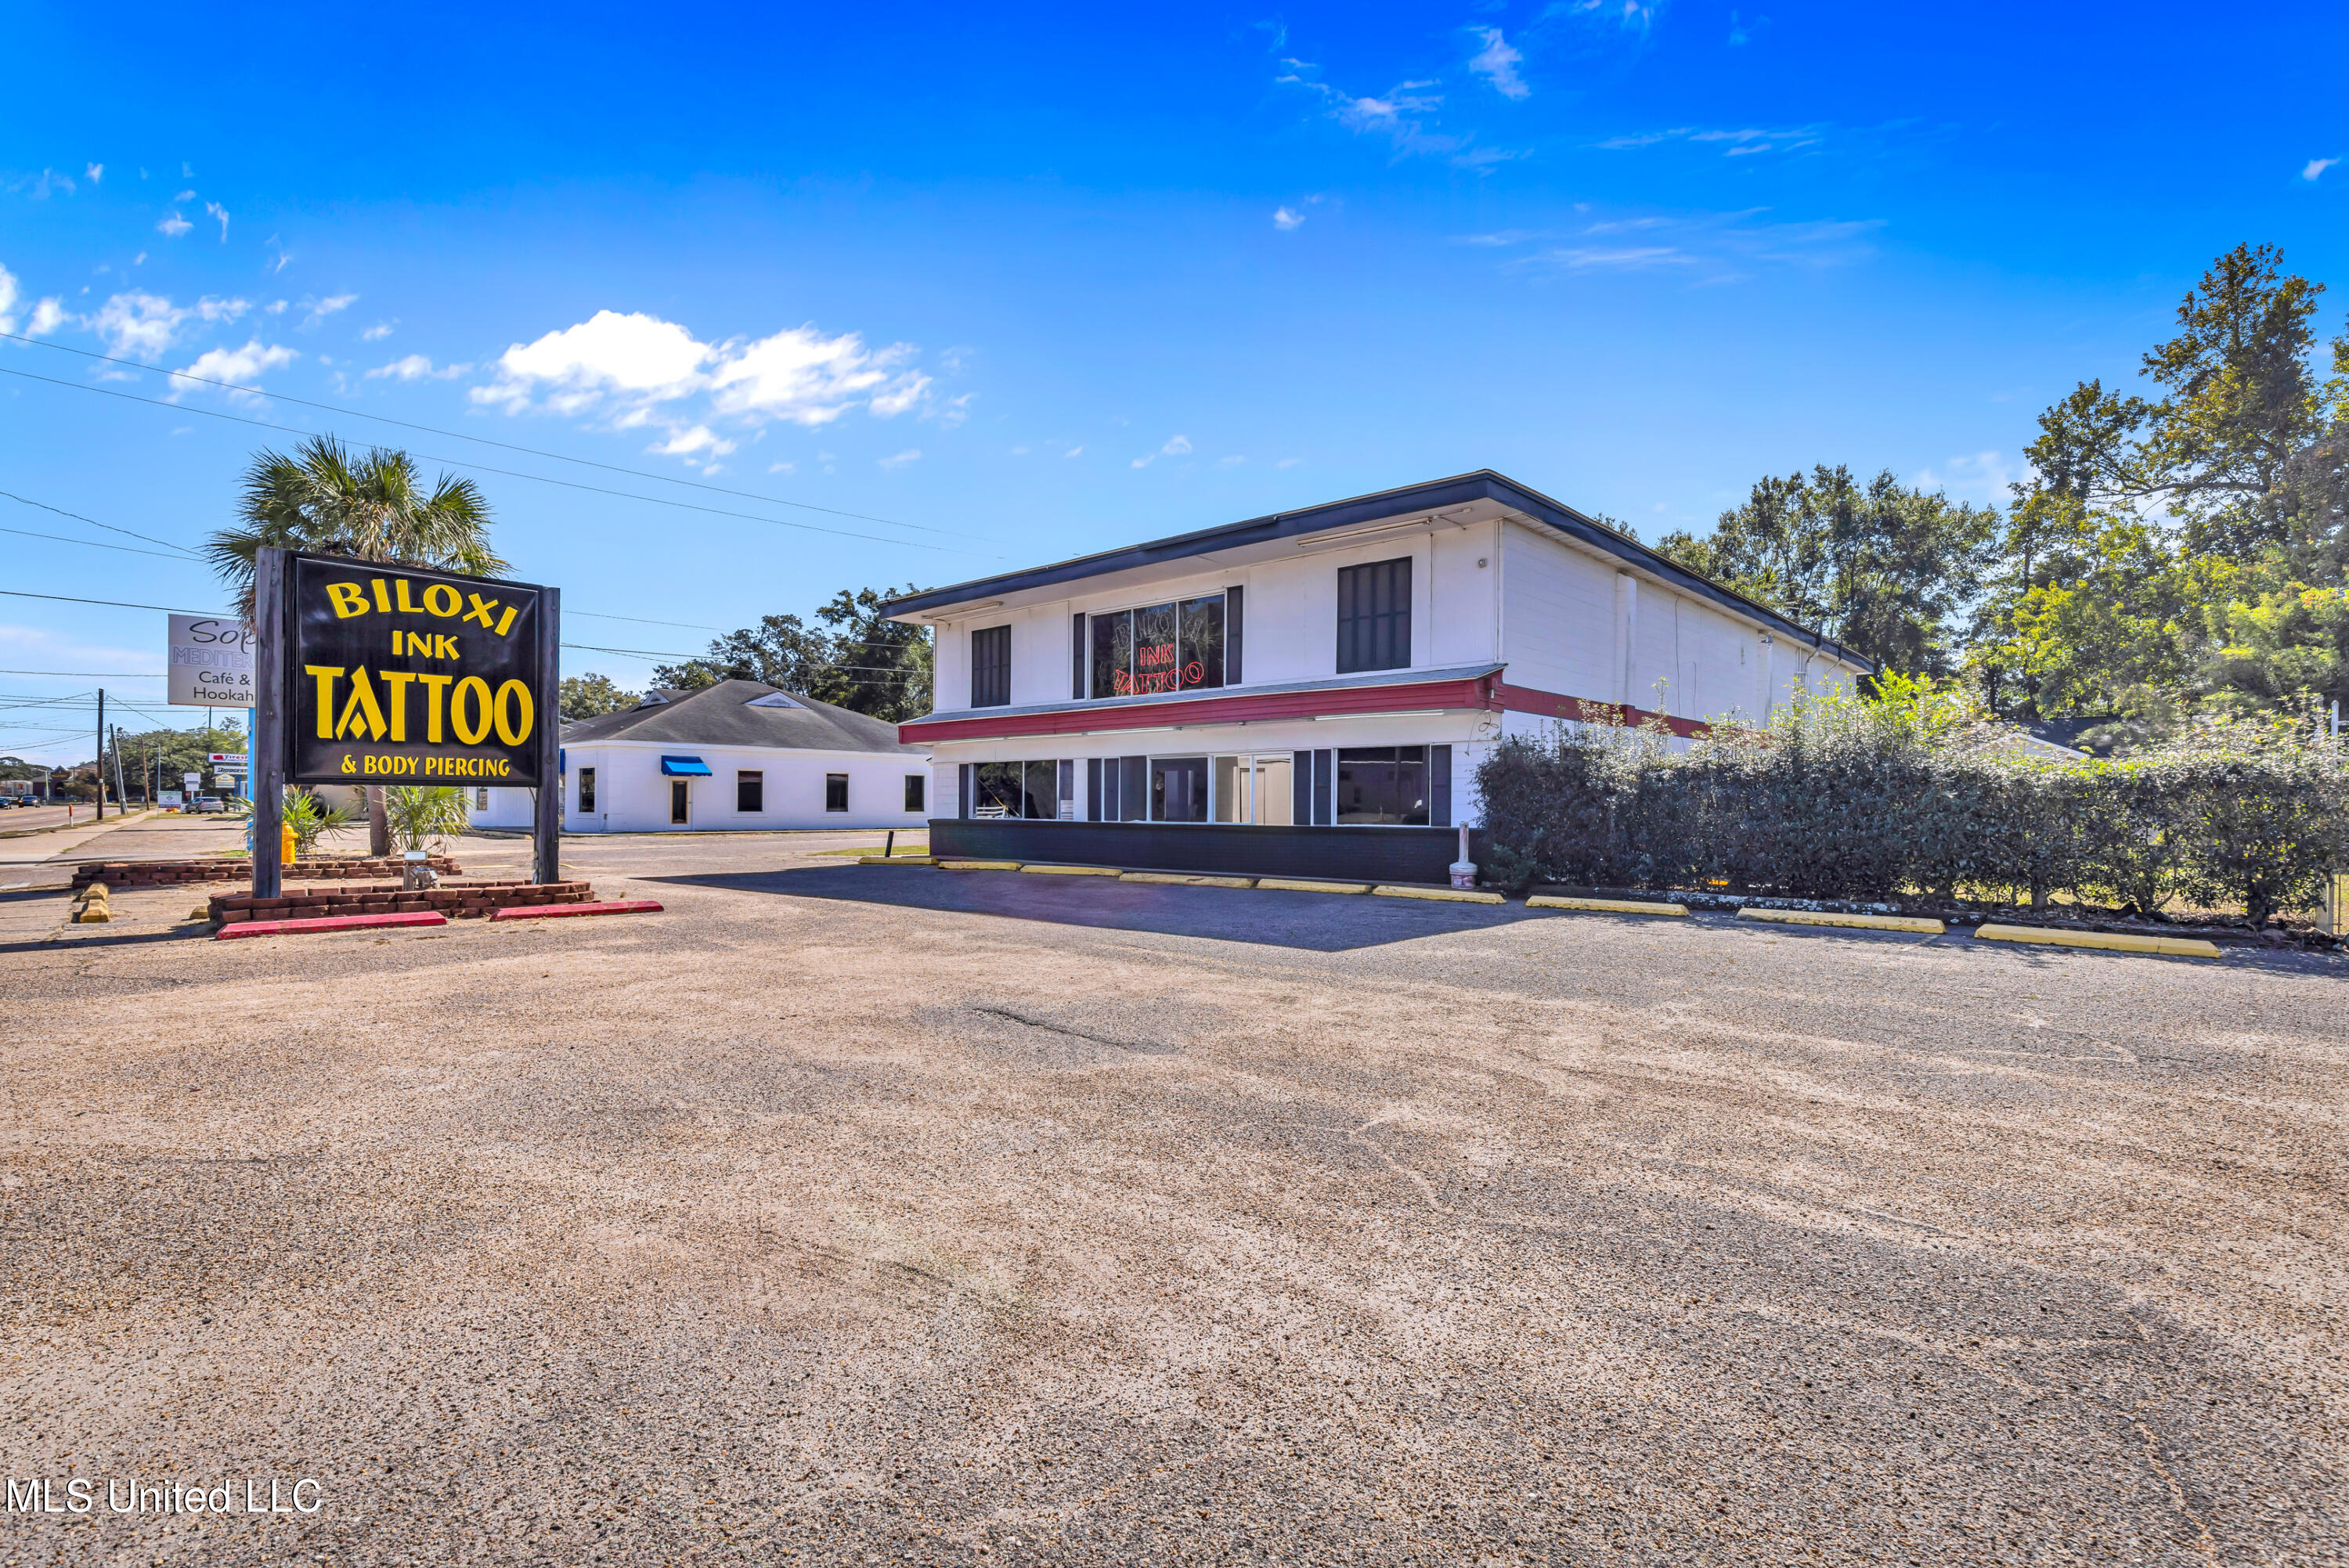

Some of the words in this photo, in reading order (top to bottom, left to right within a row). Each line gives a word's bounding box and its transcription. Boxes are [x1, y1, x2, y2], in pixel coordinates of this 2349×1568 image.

[326, 579, 518, 636] BILOXI
[392, 630, 460, 661] INK
[1139, 643, 1174, 666] INK
[199, 671, 234, 684] Café
[239, 674, 251, 686] &
[1113, 661, 1204, 694] TATTOO
[193, 687, 254, 701] Hookah
[305, 665, 534, 746] TATTOO
[341, 755, 356, 774] &
[364, 755, 419, 775] BODY
[425, 757, 510, 777] PIERCING
